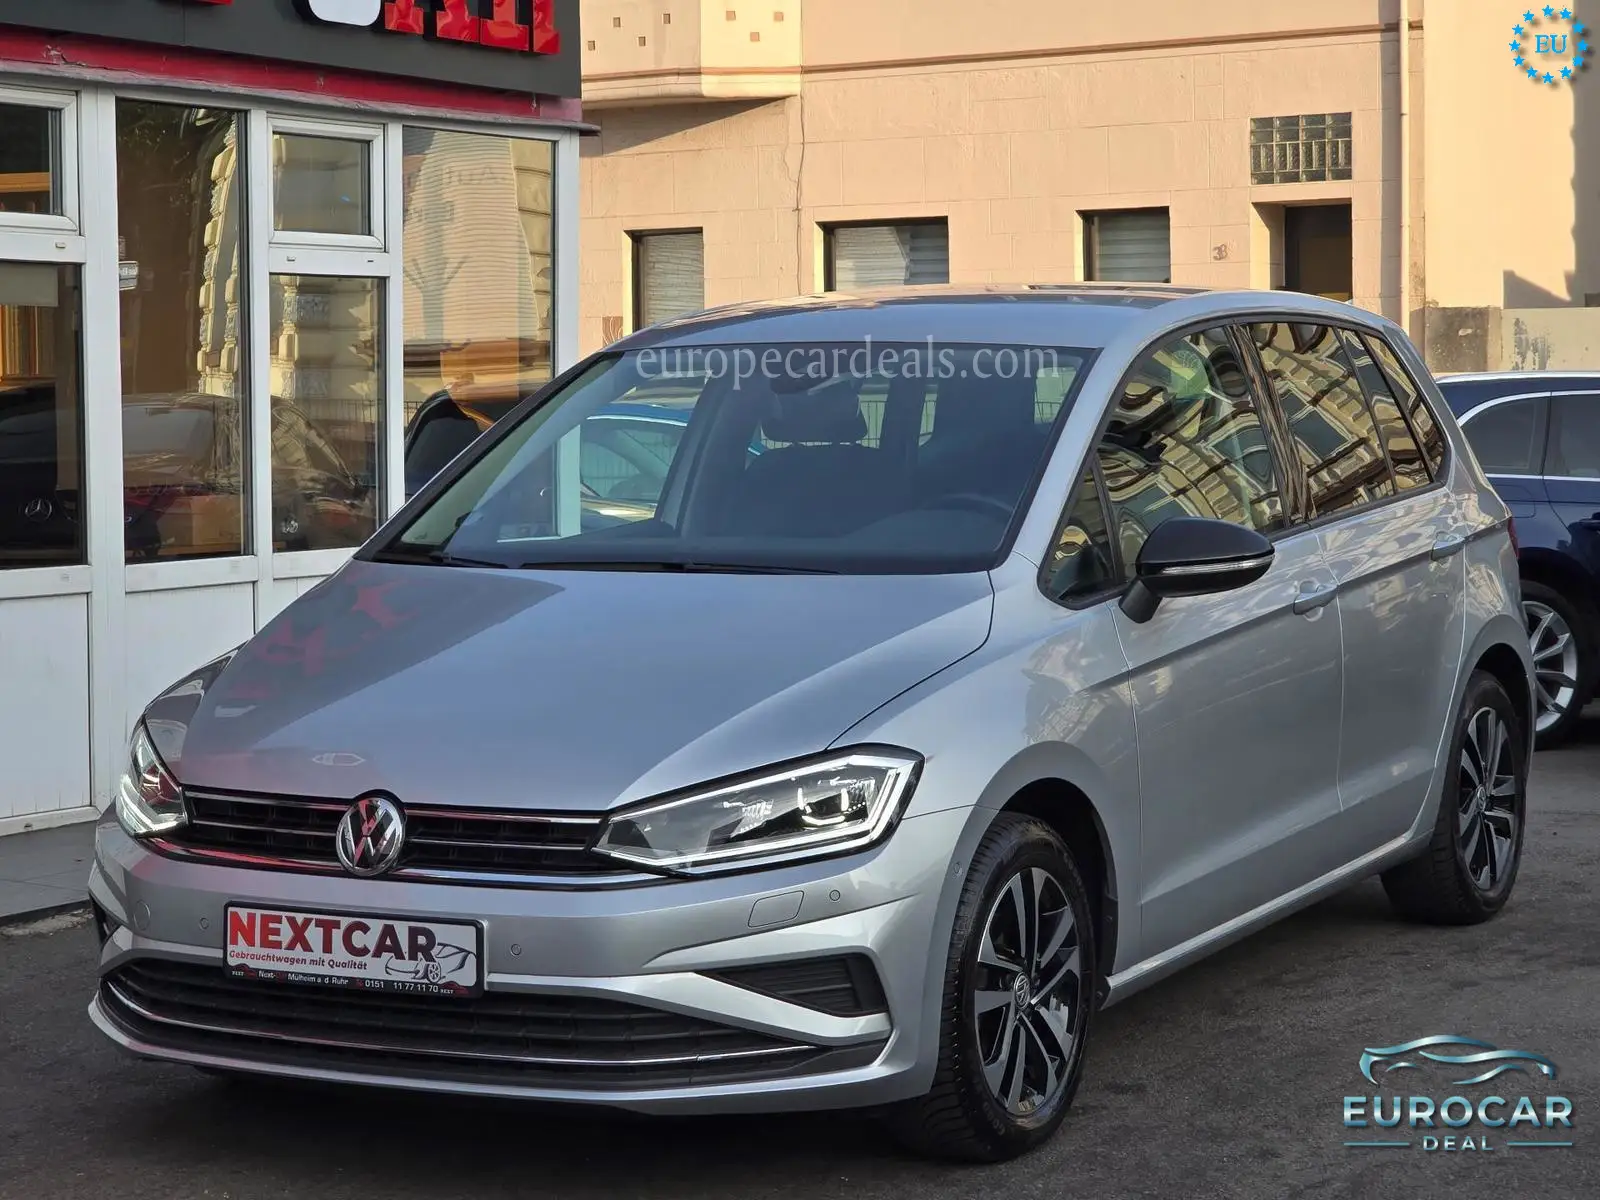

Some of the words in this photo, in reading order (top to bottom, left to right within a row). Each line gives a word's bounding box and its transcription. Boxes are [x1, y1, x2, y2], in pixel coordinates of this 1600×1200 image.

[228, 910, 438, 963] NEXTCAR
[229, 950, 306, 966] Gebrauchtwagen
[308, 957, 326, 967] mit
[327, 958, 368, 971] Qualität
[287, 972, 316, 983] Mülheim
[331, 977, 349, 986] Ruhr
[364, 980, 384, 989] 0151
